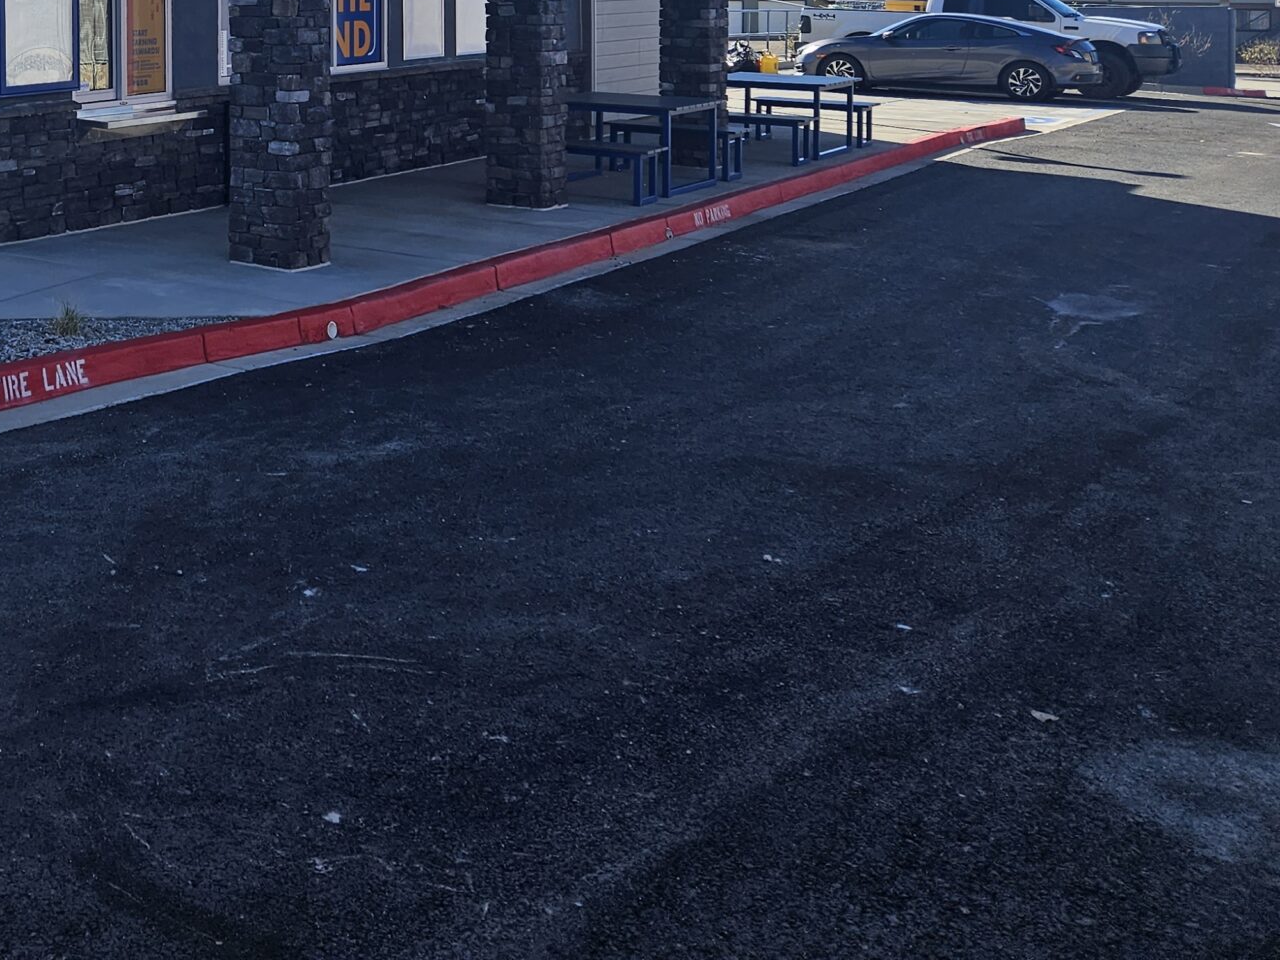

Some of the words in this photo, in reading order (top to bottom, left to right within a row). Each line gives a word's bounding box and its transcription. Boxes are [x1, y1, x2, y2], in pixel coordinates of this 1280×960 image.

[336, 20, 371, 58] ND
[693, 211, 704, 227] NO
[704, 204, 732, 225] PARKING
[42, 358, 89, 392] LANE
